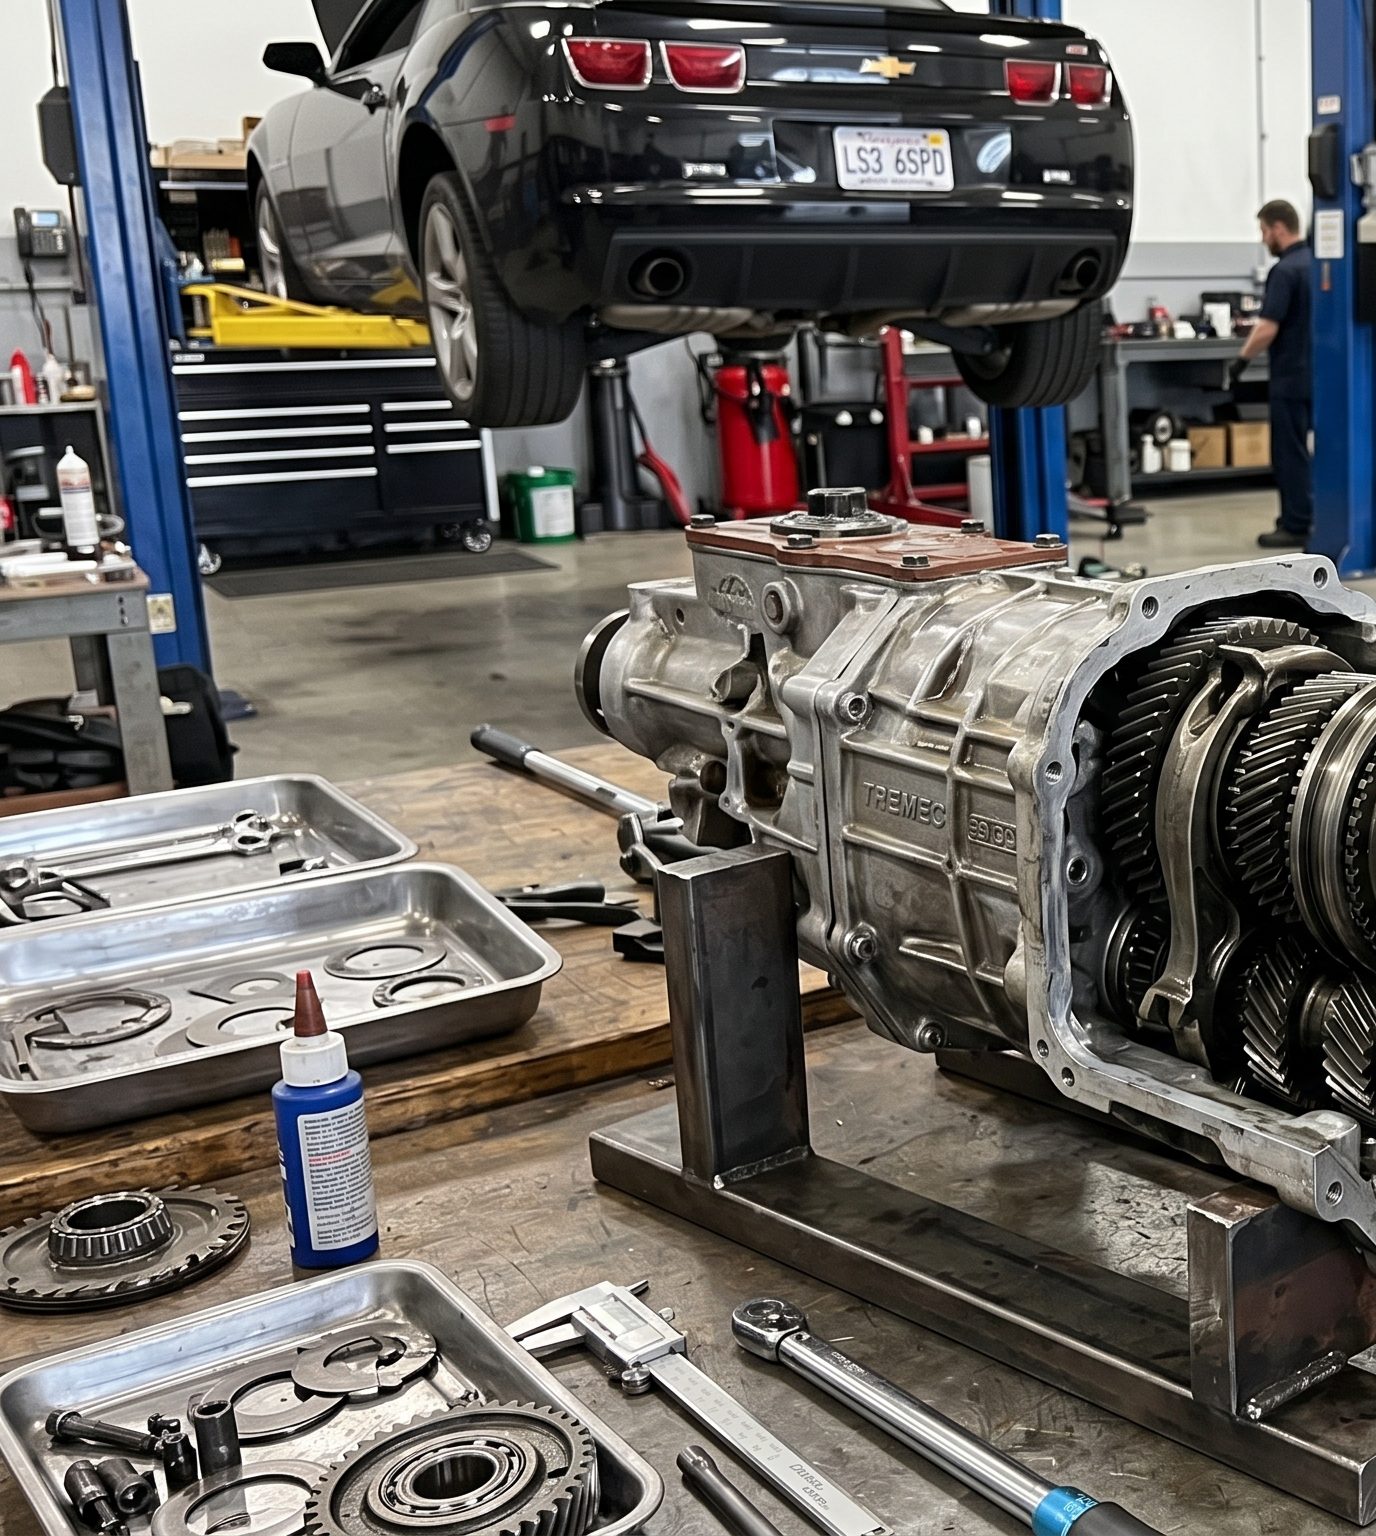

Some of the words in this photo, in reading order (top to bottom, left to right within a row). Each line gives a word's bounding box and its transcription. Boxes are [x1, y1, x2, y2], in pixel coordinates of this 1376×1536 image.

[843, 145, 884, 175] LS3
[895, 147, 946, 176] 6SPD
[863, 781, 947, 829] TREMEC
